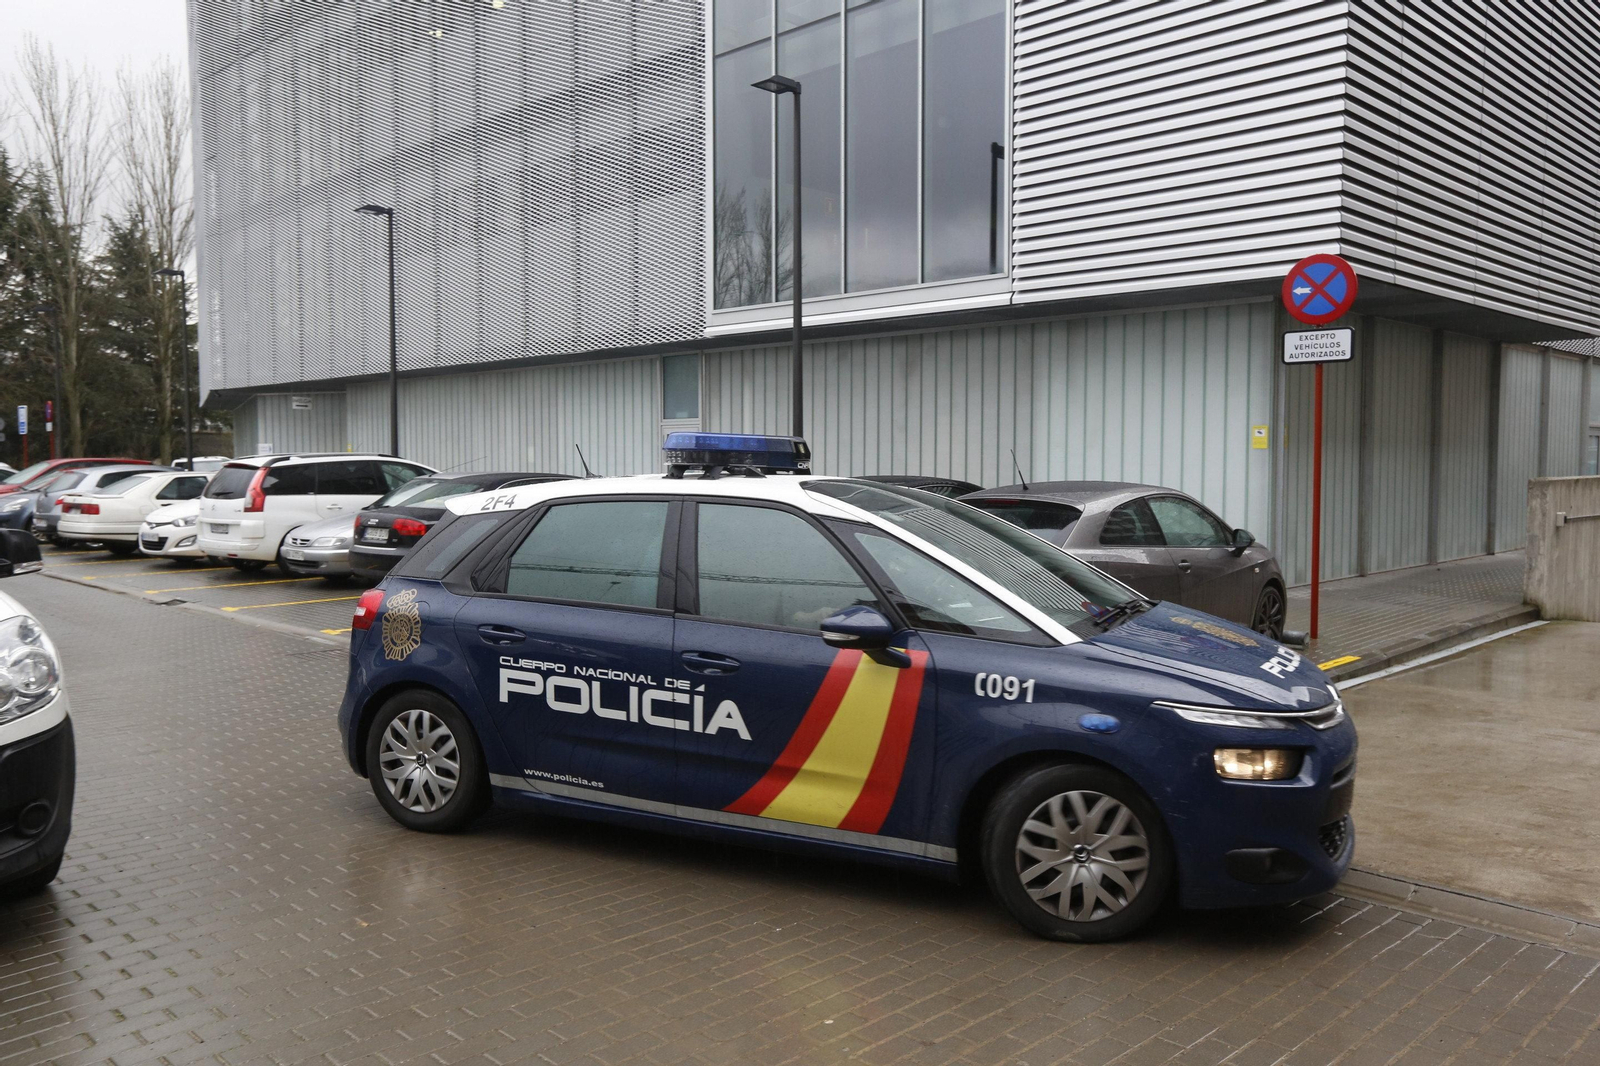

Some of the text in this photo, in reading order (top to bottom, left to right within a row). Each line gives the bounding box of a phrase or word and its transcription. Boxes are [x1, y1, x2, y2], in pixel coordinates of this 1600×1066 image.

[1294, 341, 1341, 351] VEHÍCULOS
[1299, 333, 1336, 342] EXCEPTO
[1289, 350, 1346, 360] AUTORIZADOS
[480, 494, 517, 511] 2F4
[499, 656, 567, 673] CUERPO
[664, 677, 691, 690] DE
[499, 667, 753, 741] POLICÍA
[524, 768, 605, 788] www.policia.es
